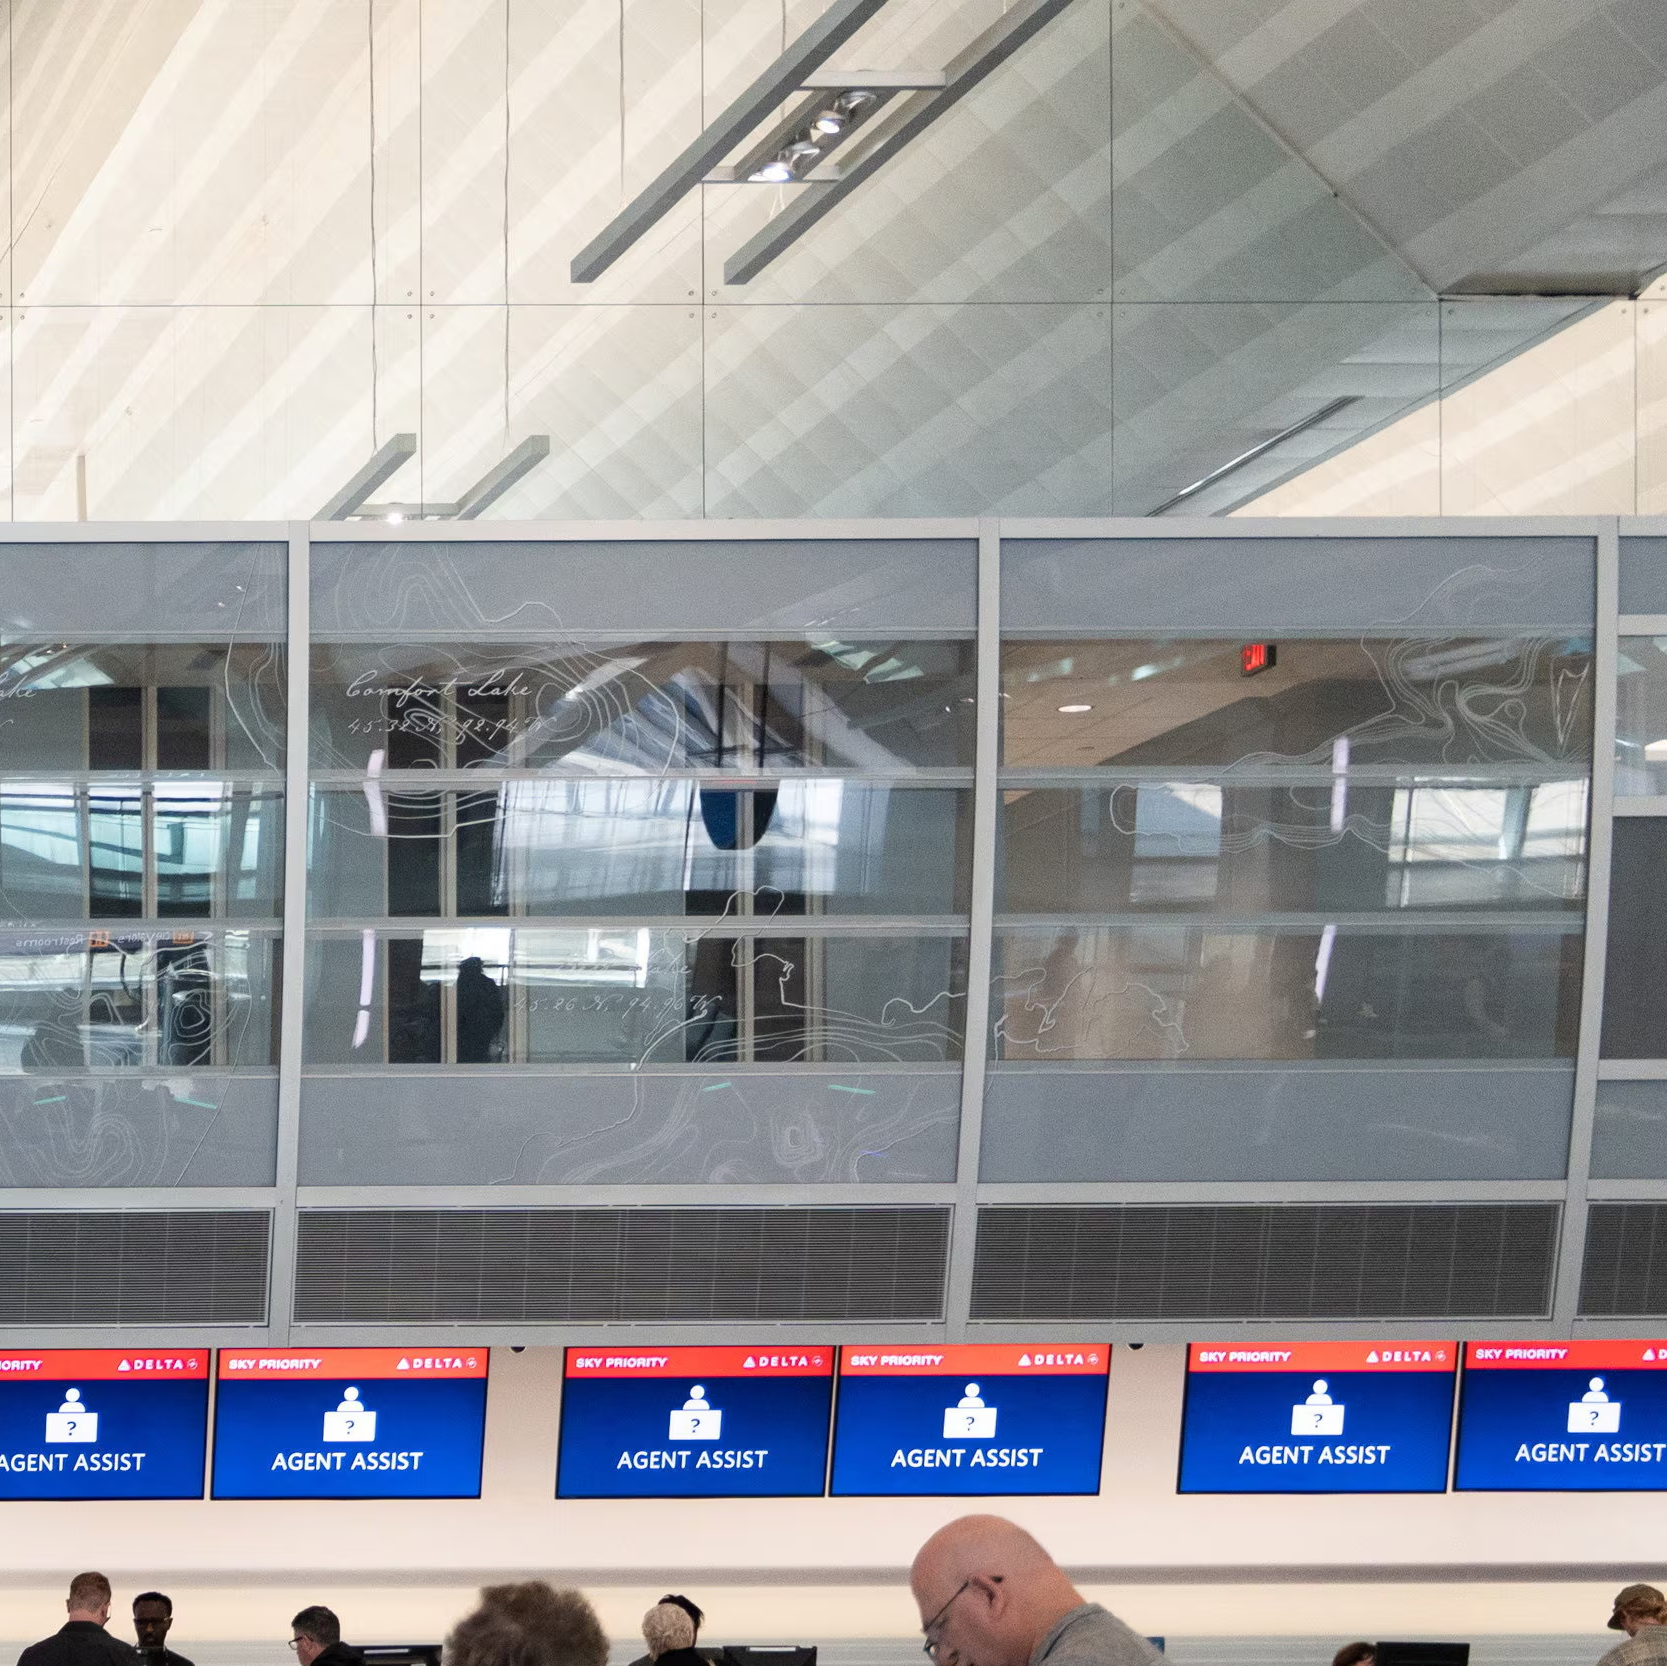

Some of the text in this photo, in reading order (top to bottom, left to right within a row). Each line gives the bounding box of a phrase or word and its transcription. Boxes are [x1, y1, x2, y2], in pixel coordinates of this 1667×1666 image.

[346, 669, 532, 708] Comfort Lake
[1035, 1354, 1083, 1365] DELTA
[1200, 1352, 1291, 1362] SKY PRIORITY
[1382, 1351, 1431, 1362] DELTA
[1476, 1349, 1567, 1359] SKY PRIORITY
[134, 1360, 182, 1369] DELTA
[229, 1359, 322, 1369] SKY PRIORITY
[413, 1358, 462, 1368] DELTA
[576, 1358, 667, 1367] SKY PRIORITY
[759, 1357, 807, 1366] DELTA
[851, 1355, 944, 1365] SKY PRIORITY
[891, 1449, 1043, 1467] AGENT ASSIST
[1239, 1446, 1390, 1464] AGENT ASSIST
[1515, 1444, 1666, 1462] AGENT ASSIST
[74, 1453, 145, 1471] ASSIST
[272, 1452, 423, 1470] AGENT ASSIST
[617, 1451, 768, 1469] AGENT ASSIST
